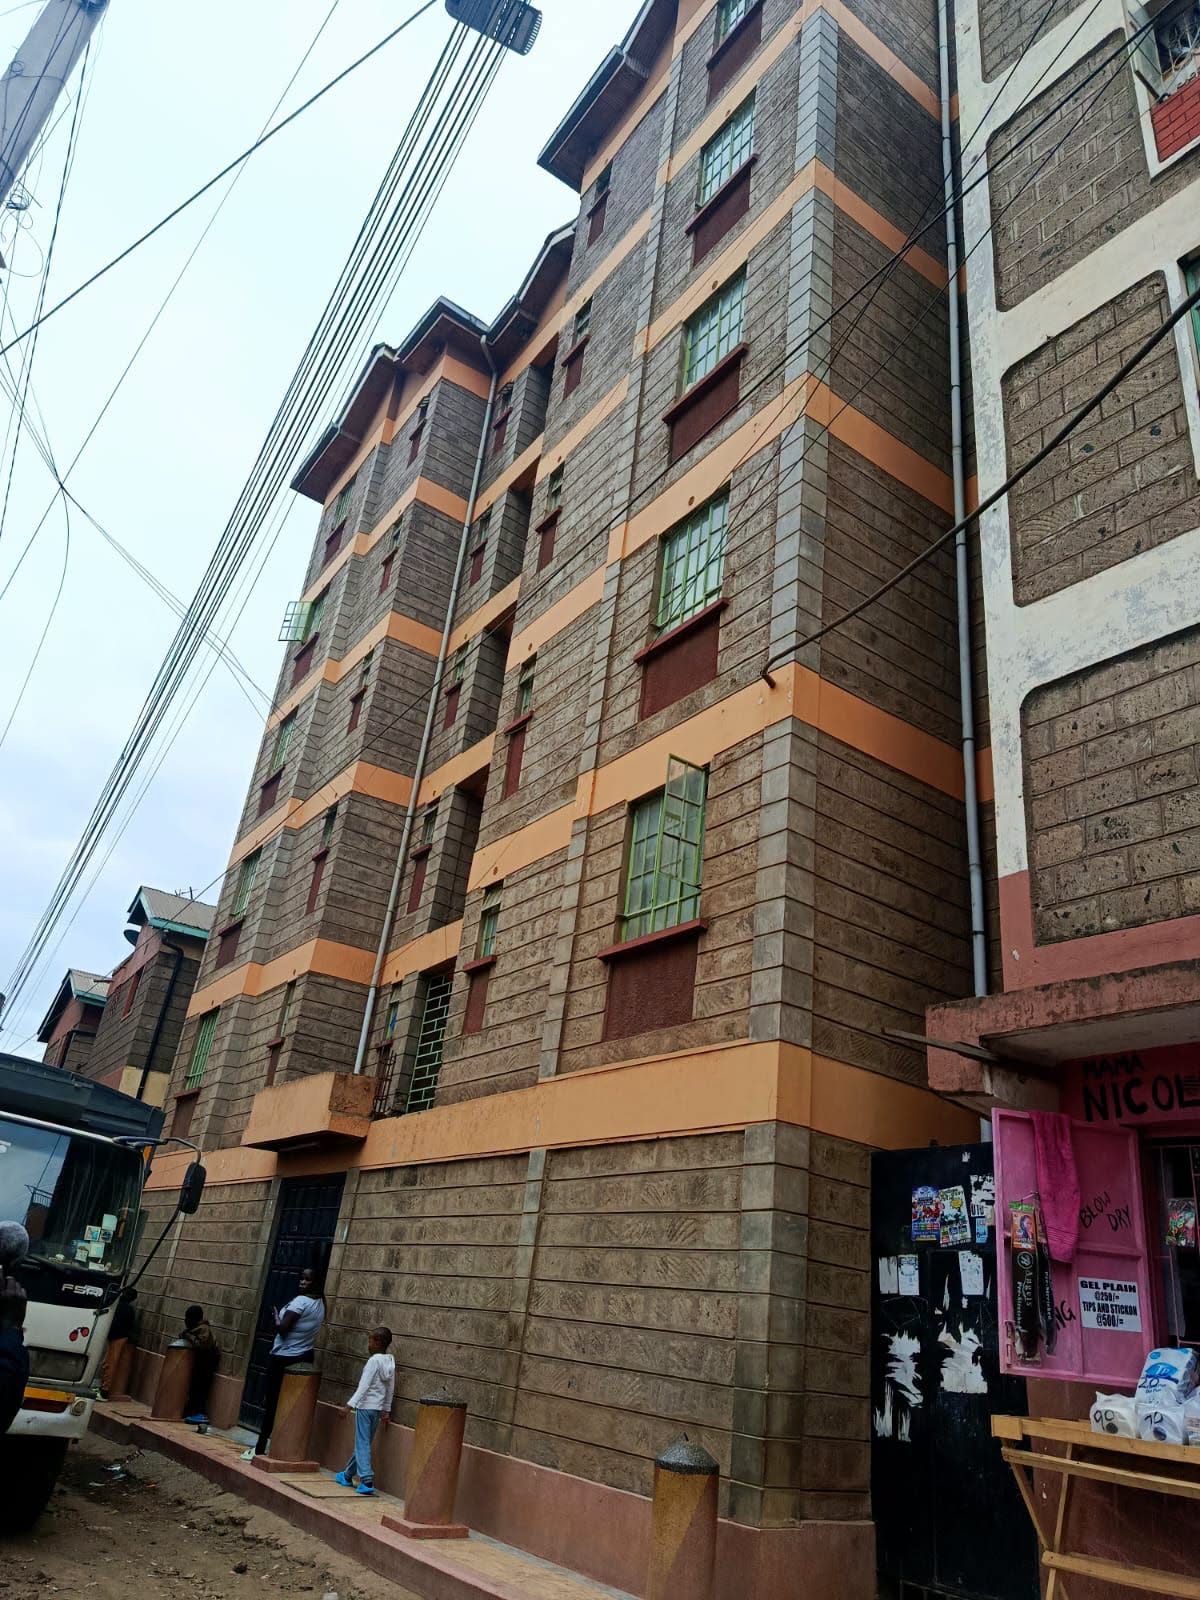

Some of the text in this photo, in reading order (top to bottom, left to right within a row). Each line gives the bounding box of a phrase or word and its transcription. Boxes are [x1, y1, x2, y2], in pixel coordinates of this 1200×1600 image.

[1083, 1055, 1144, 1078] MAMA
[1080, 1191, 1111, 1229] BLOW
[1107, 1205, 1132, 1232] DRY
[62, 1283, 104, 1297] FSR
[1080, 1280, 1137, 1293] GEL PLAIN
[1094, 1290, 1120, 1303] @250/=
[1082, 1302, 1138, 1316] TIPS AND STICKON
[1096, 1315, 1124, 1328] @500/=
[1093, 1409, 1115, 1431] 90
